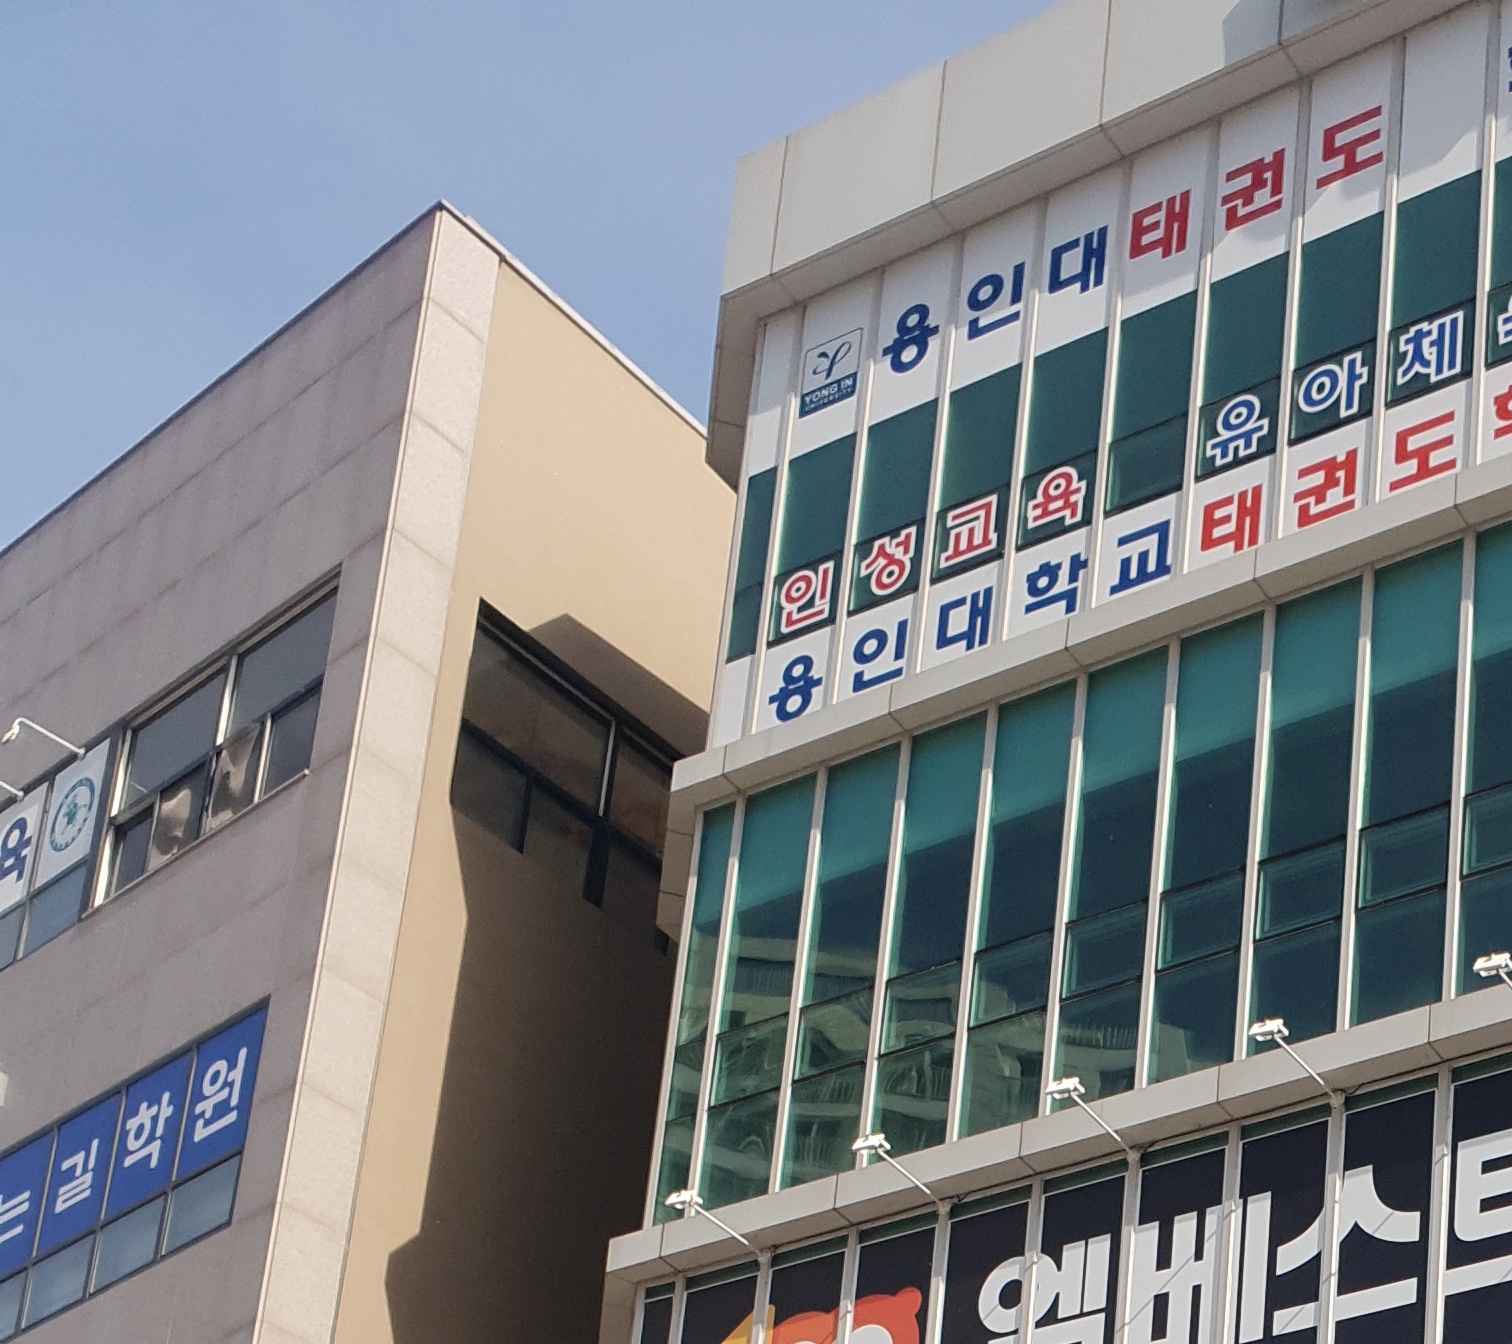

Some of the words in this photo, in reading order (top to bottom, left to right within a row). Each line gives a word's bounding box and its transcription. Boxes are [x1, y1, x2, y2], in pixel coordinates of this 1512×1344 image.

[882, 225, 1109, 374] 용인대
[1129, 105, 1386, 260] 태권도
[803, 383, 838, 404] YONG
[841, 377, 853, 389] IN
[768, 518, 1173, 724] 용인대학교
[779, 466, 1089, 634] 인성교육
